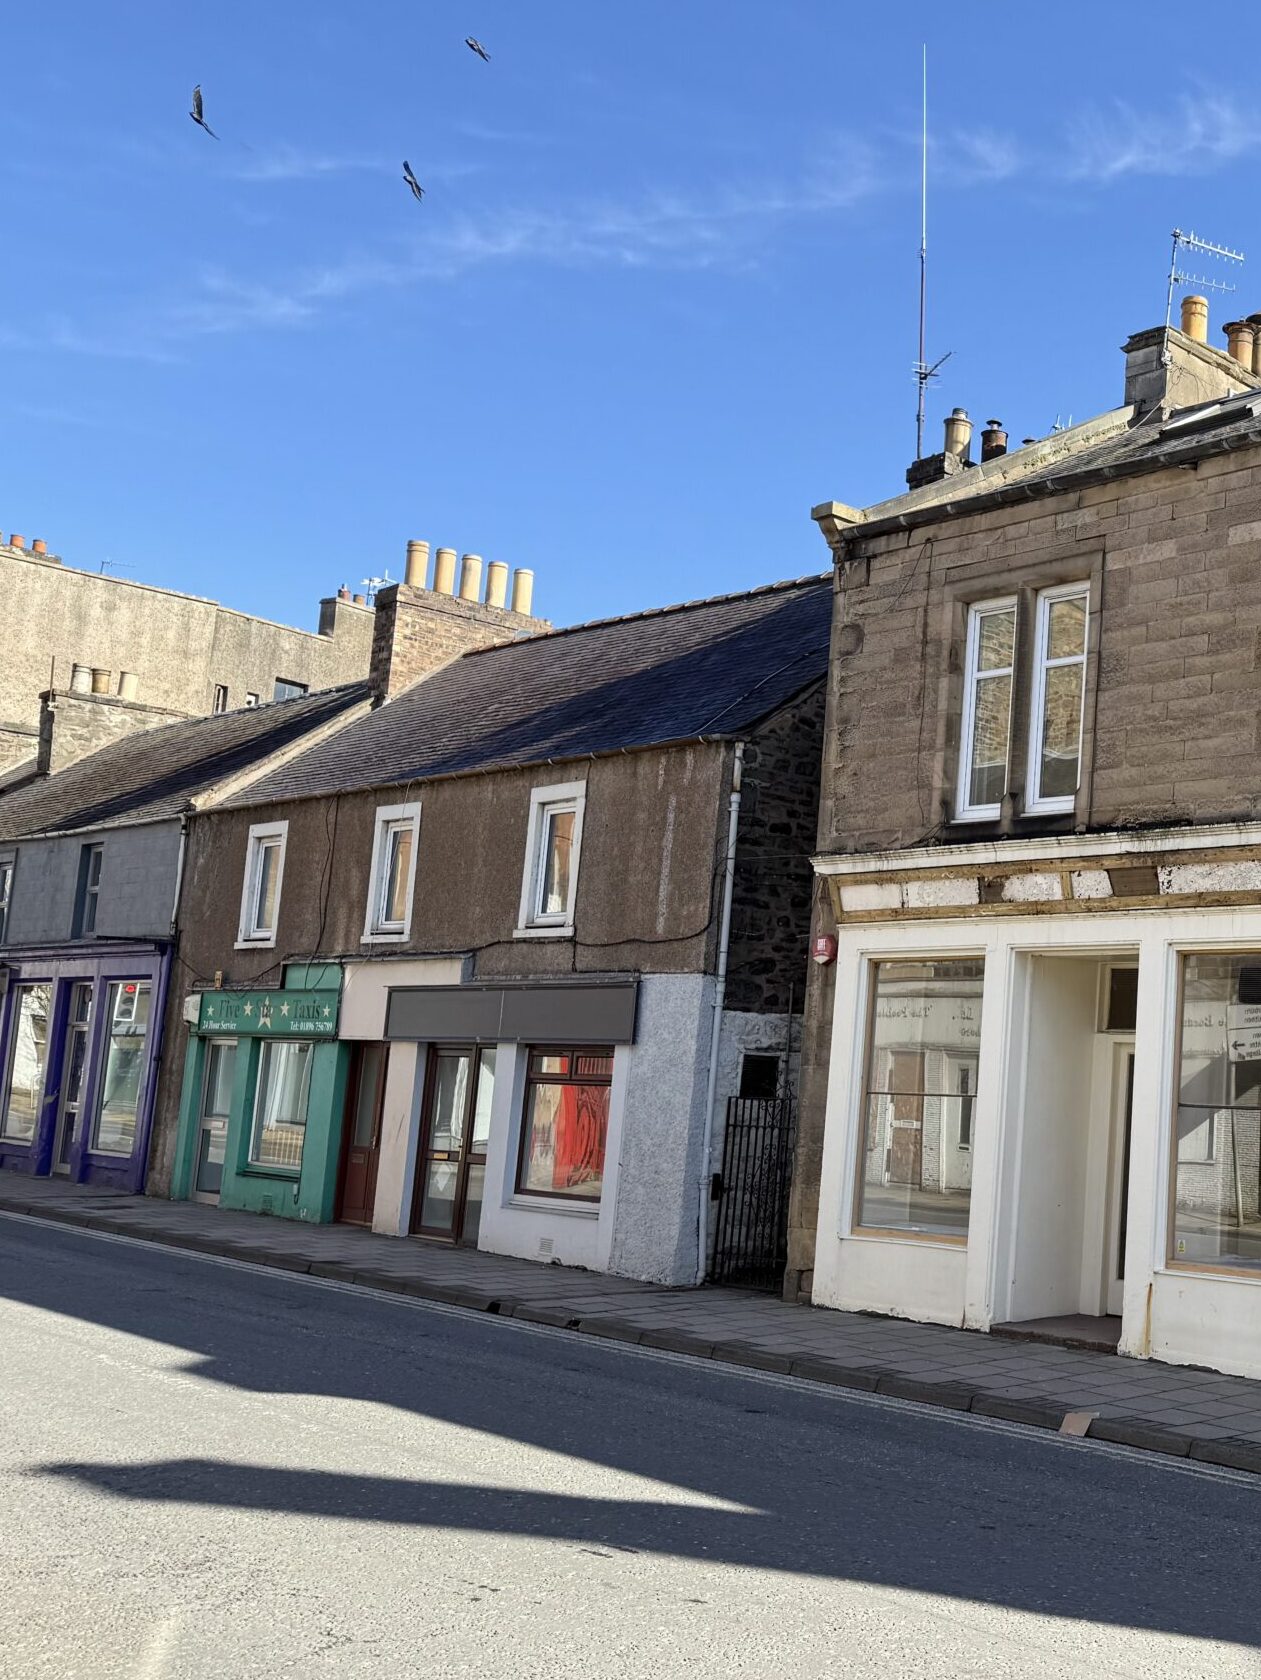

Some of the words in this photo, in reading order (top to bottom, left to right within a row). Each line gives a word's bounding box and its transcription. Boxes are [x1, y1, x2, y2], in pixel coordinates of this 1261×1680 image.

[219, 1000, 240, 1019] Five
[293, 1000, 321, 1020] Taxis
[208, 1020, 220, 1029] Hour
[220, 1020, 237, 1030] Service
